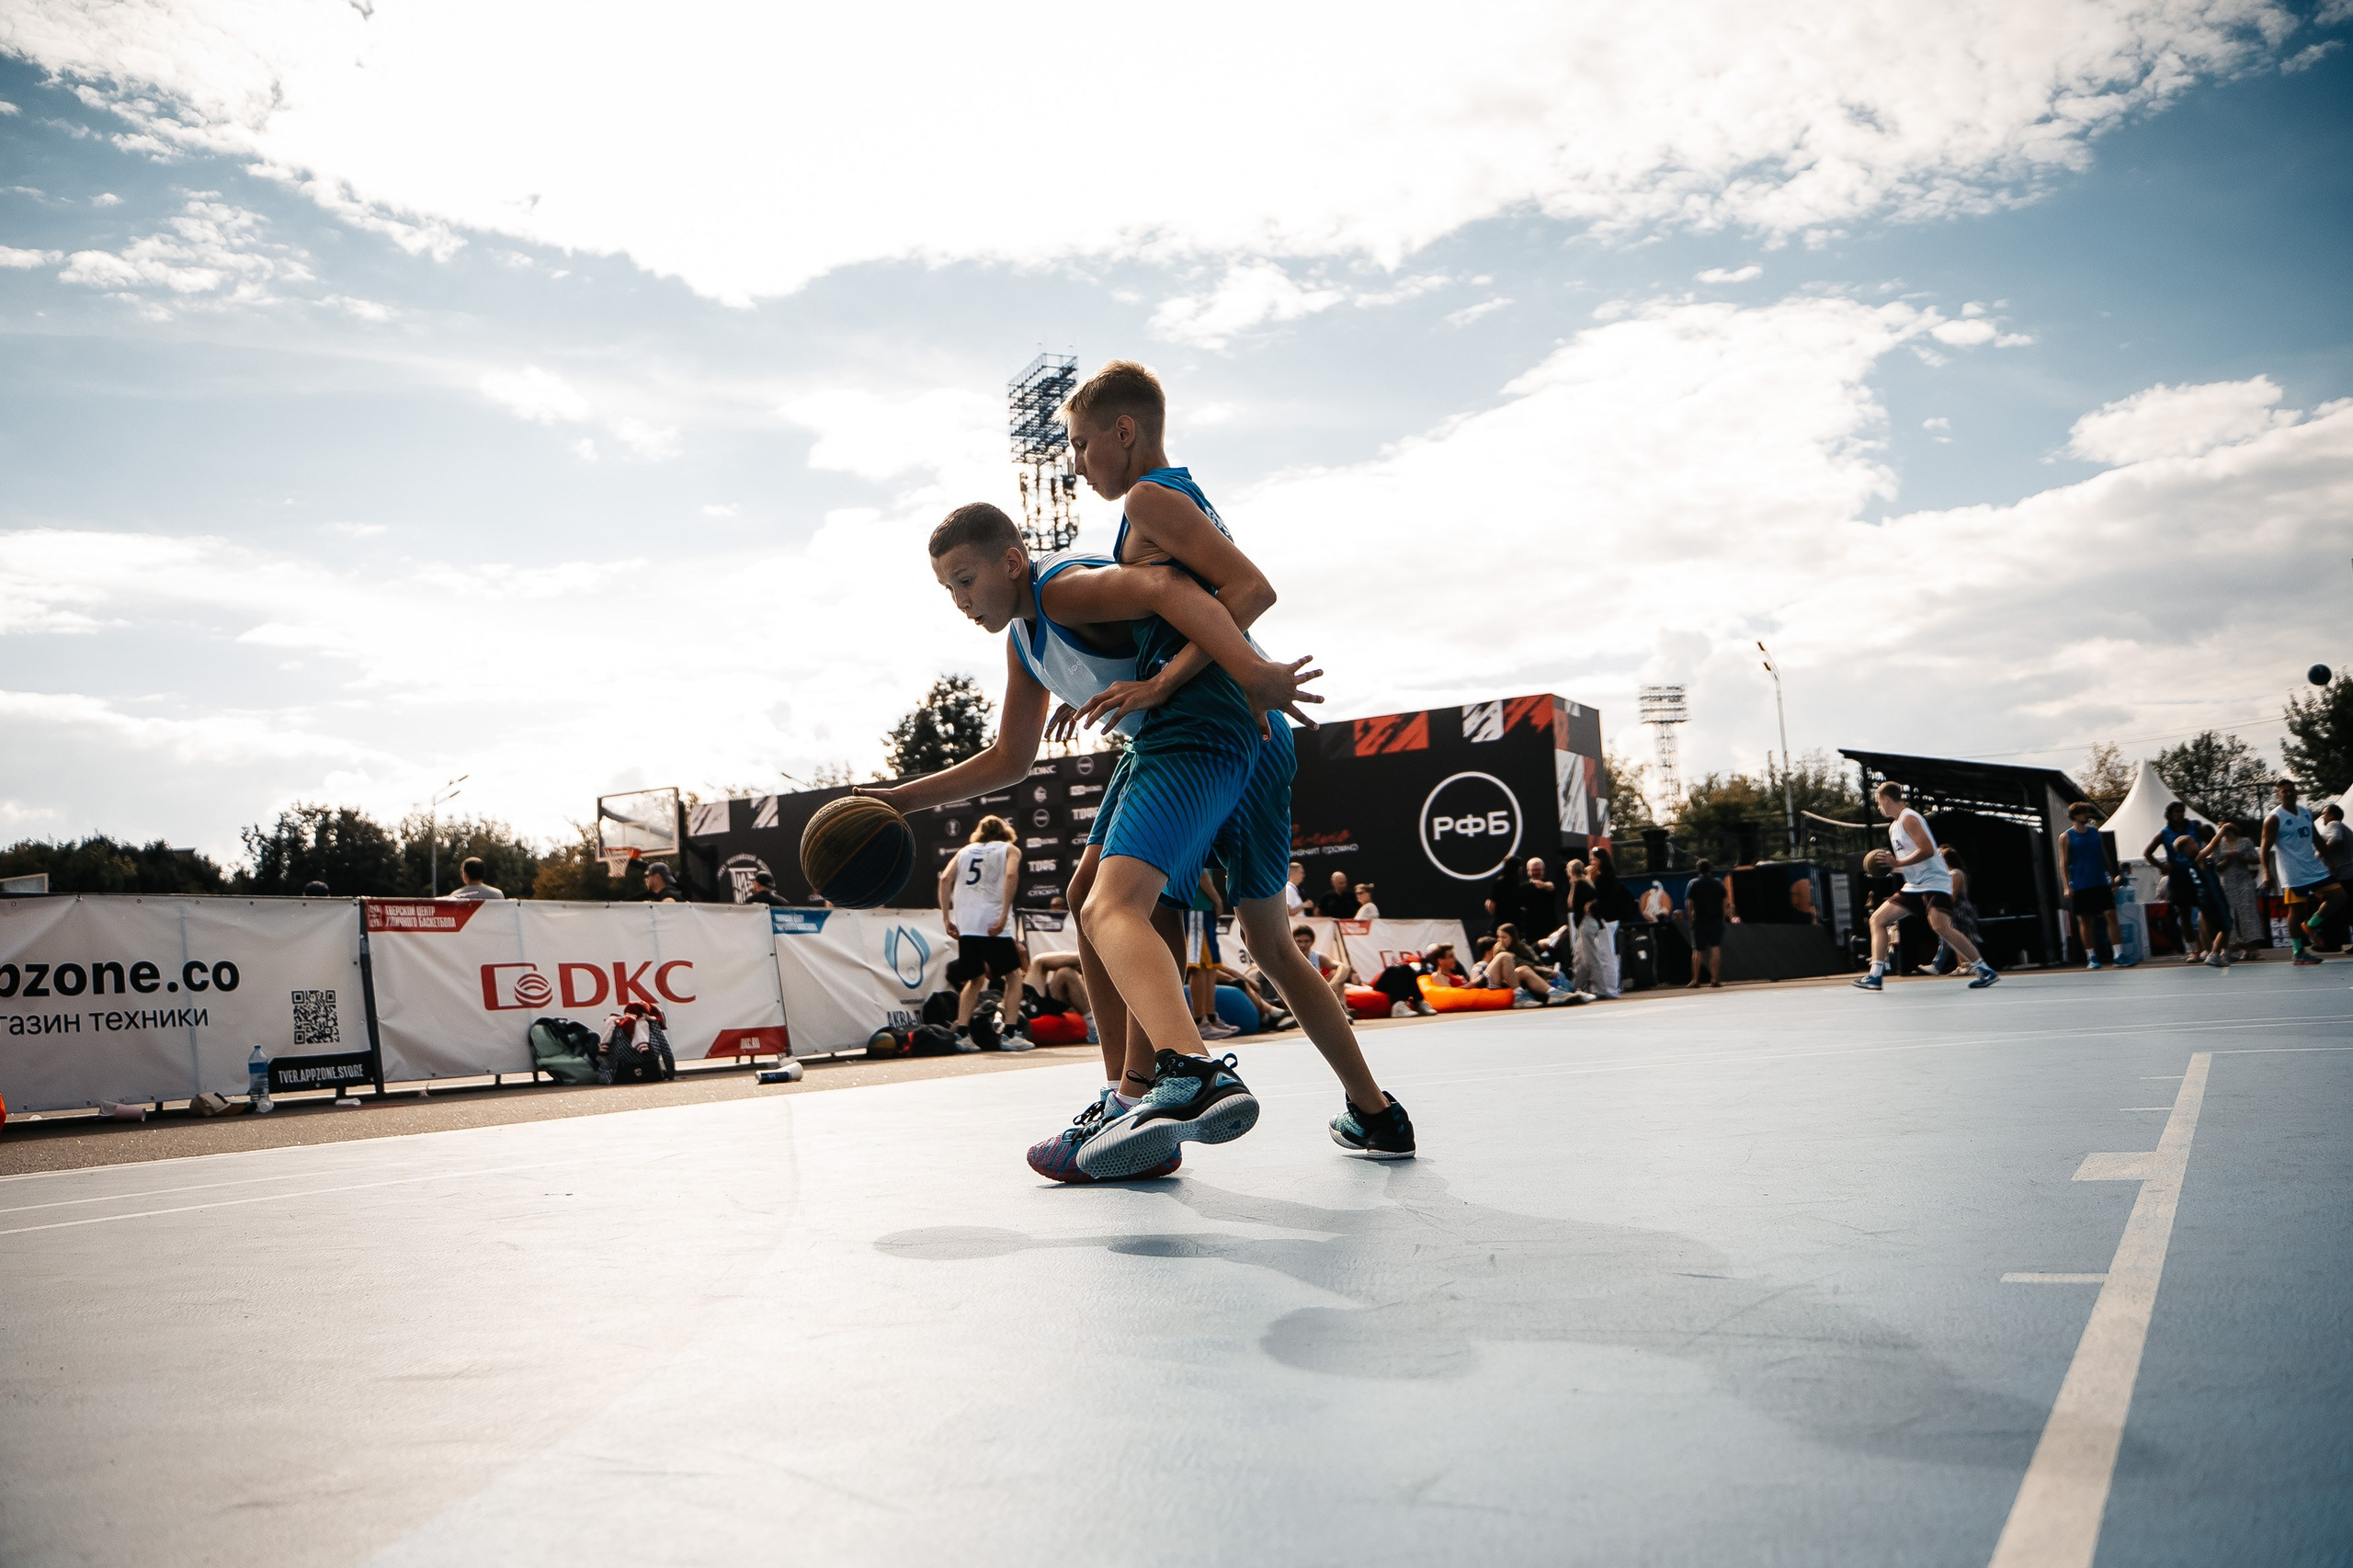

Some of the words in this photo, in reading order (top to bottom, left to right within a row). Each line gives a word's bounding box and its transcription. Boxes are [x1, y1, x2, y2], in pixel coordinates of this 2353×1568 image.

[1432, 811, 1511, 841] РФБ
[965, 858, 983, 885] 5
[557, 960, 698, 1008] DKC
[88, 1007, 210, 1031] техники
[278, 1063, 365, 1084] TVER.APPZONE.STORE
